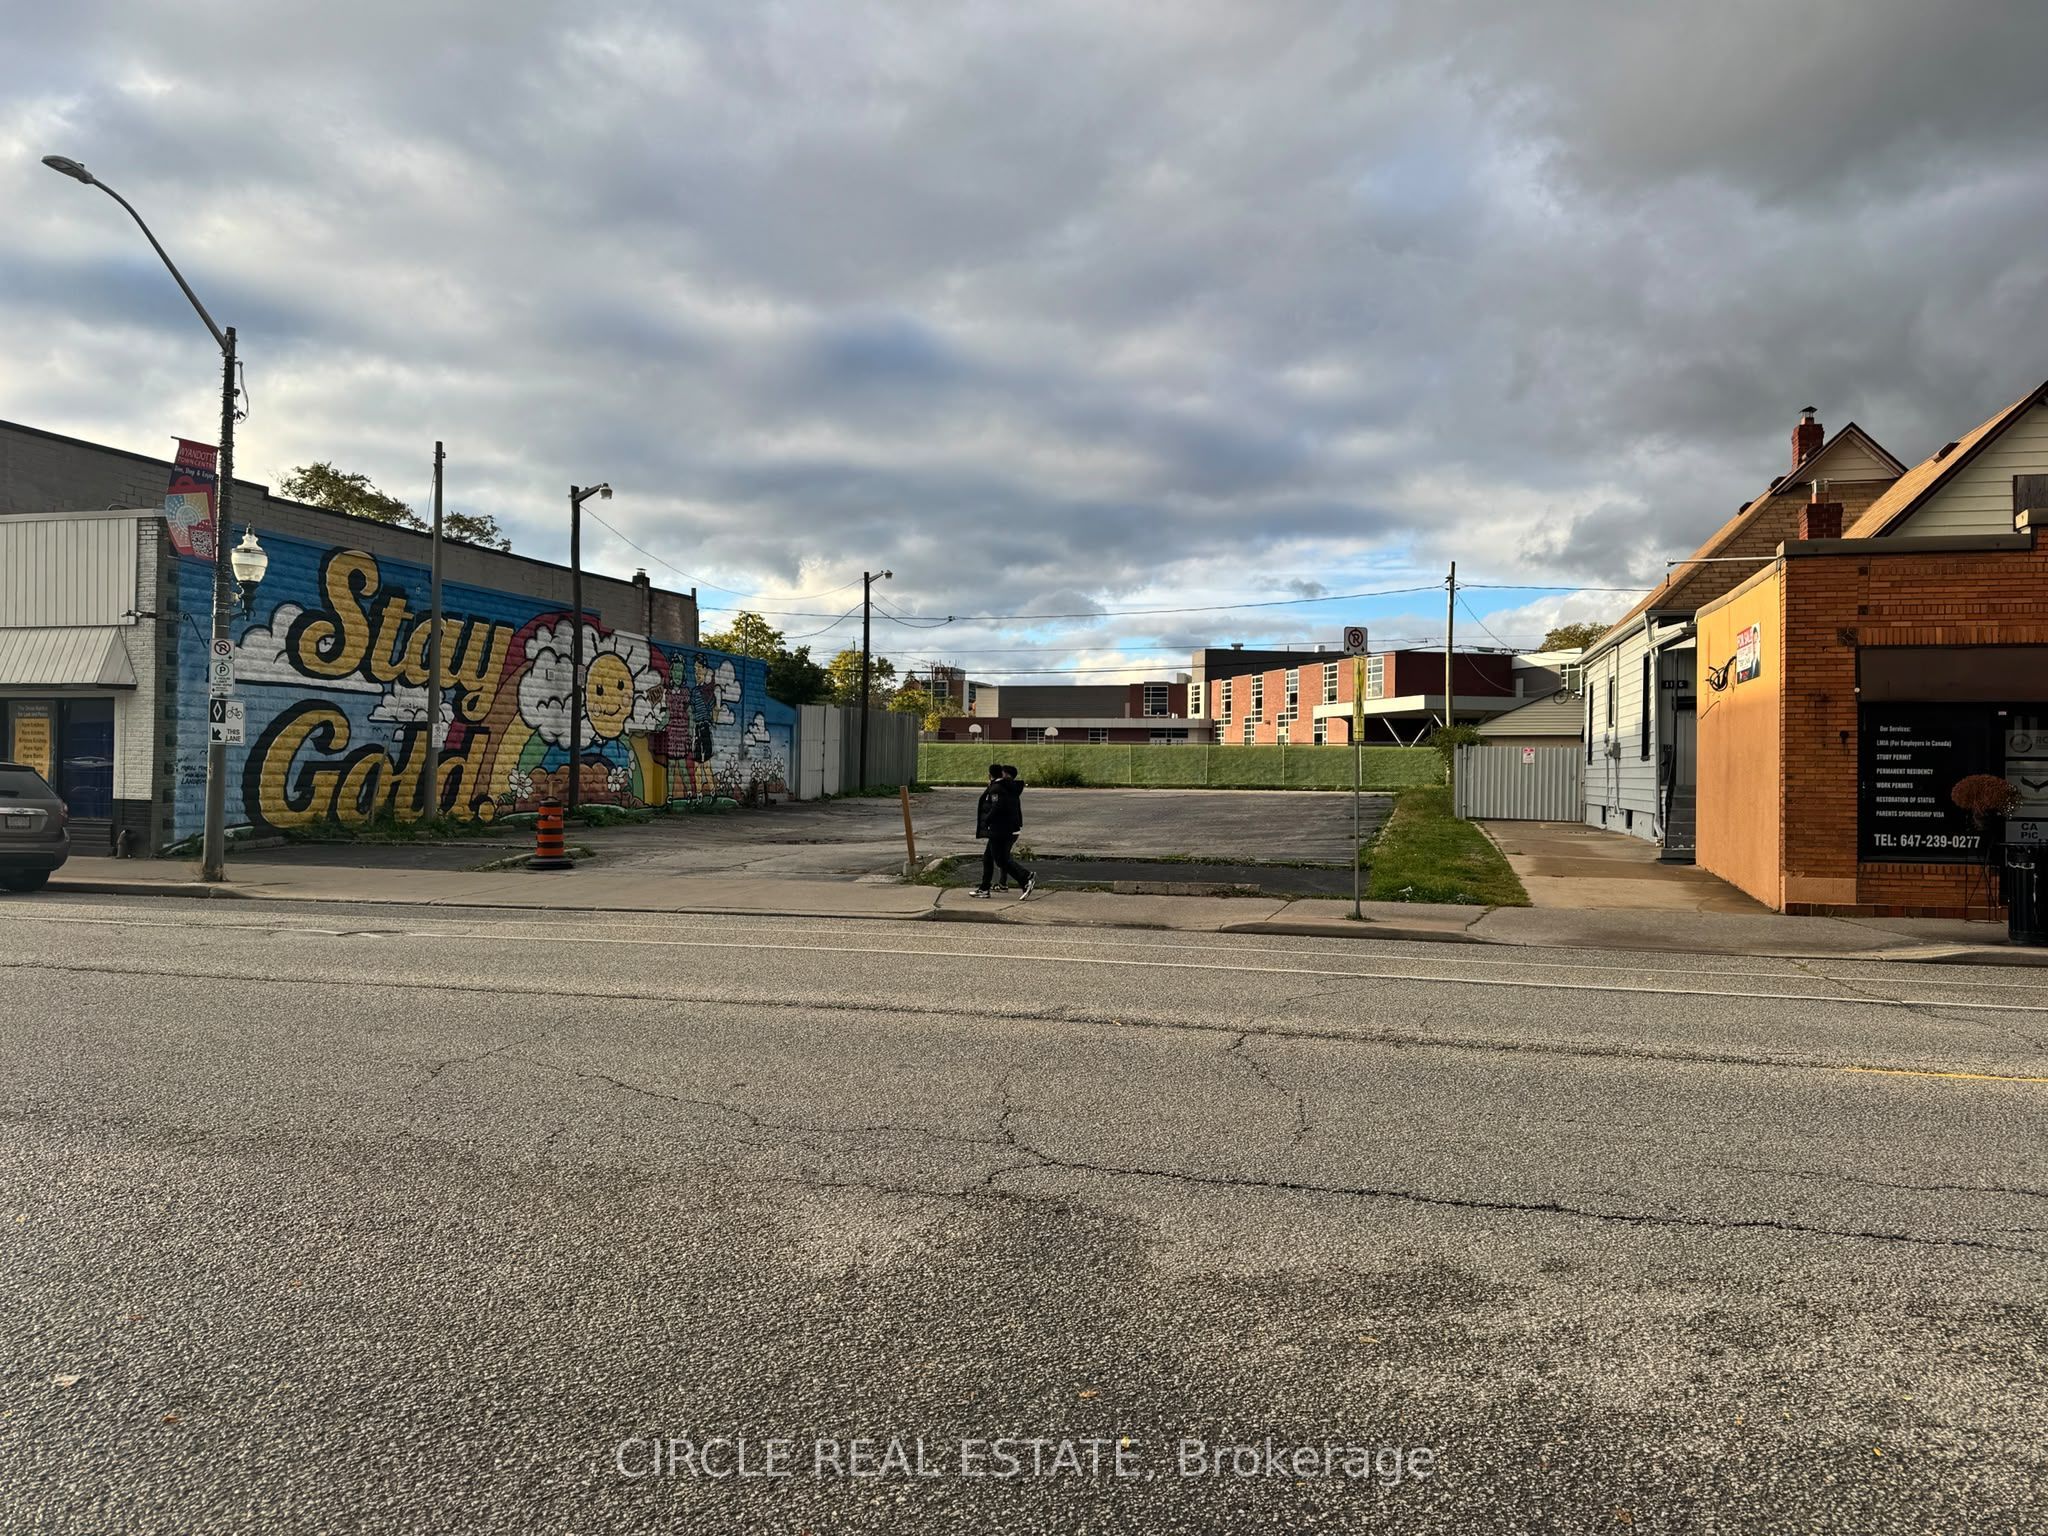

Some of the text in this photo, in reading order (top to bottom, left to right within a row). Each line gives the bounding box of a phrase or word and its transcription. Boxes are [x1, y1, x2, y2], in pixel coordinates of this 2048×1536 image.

[291, 547, 514, 722] Stay
[250, 703, 496, 830] Gold.
[1874, 833, 1980, 849] TEL: 647-239-0277
[2020, 822, 2038, 830] CA
